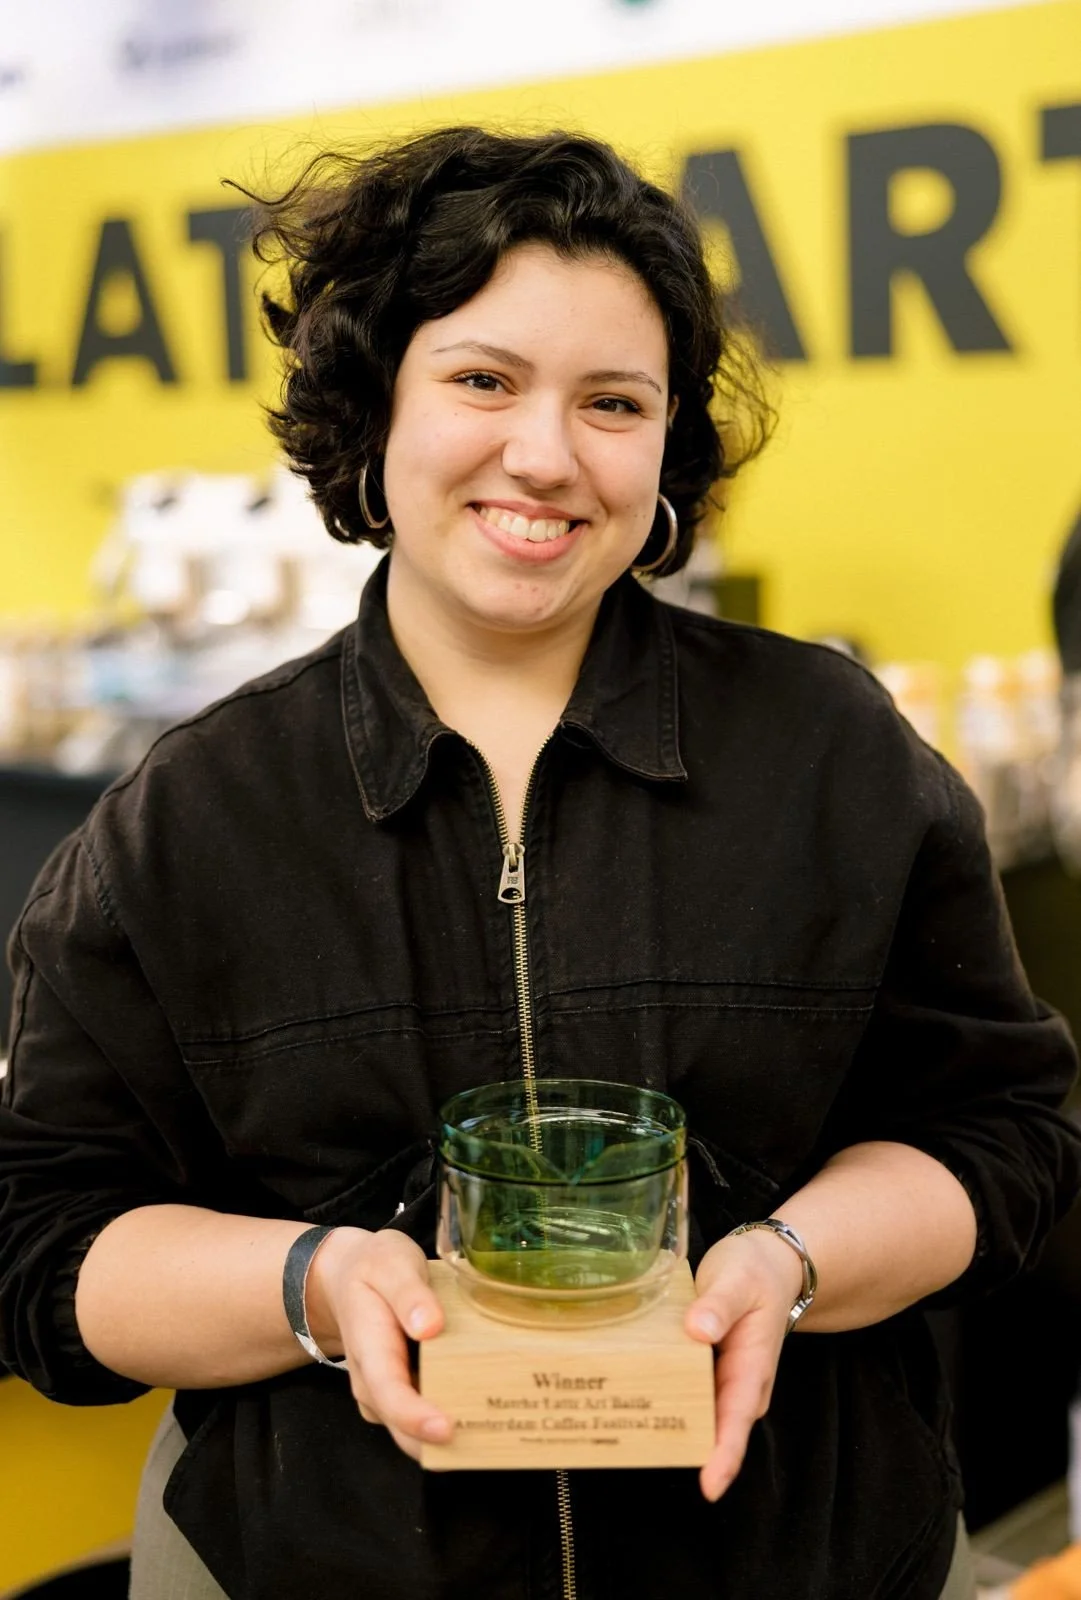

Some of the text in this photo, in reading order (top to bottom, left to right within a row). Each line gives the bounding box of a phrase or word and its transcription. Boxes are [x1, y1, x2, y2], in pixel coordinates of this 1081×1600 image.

[532, 1373, 608, 1390] Winner
[584, 1396, 607, 1410] Art
[455, 1417, 536, 1431] Amsterdam
[541, 1416, 587, 1431] Coffee
[592, 1416, 649, 1430] Festival
